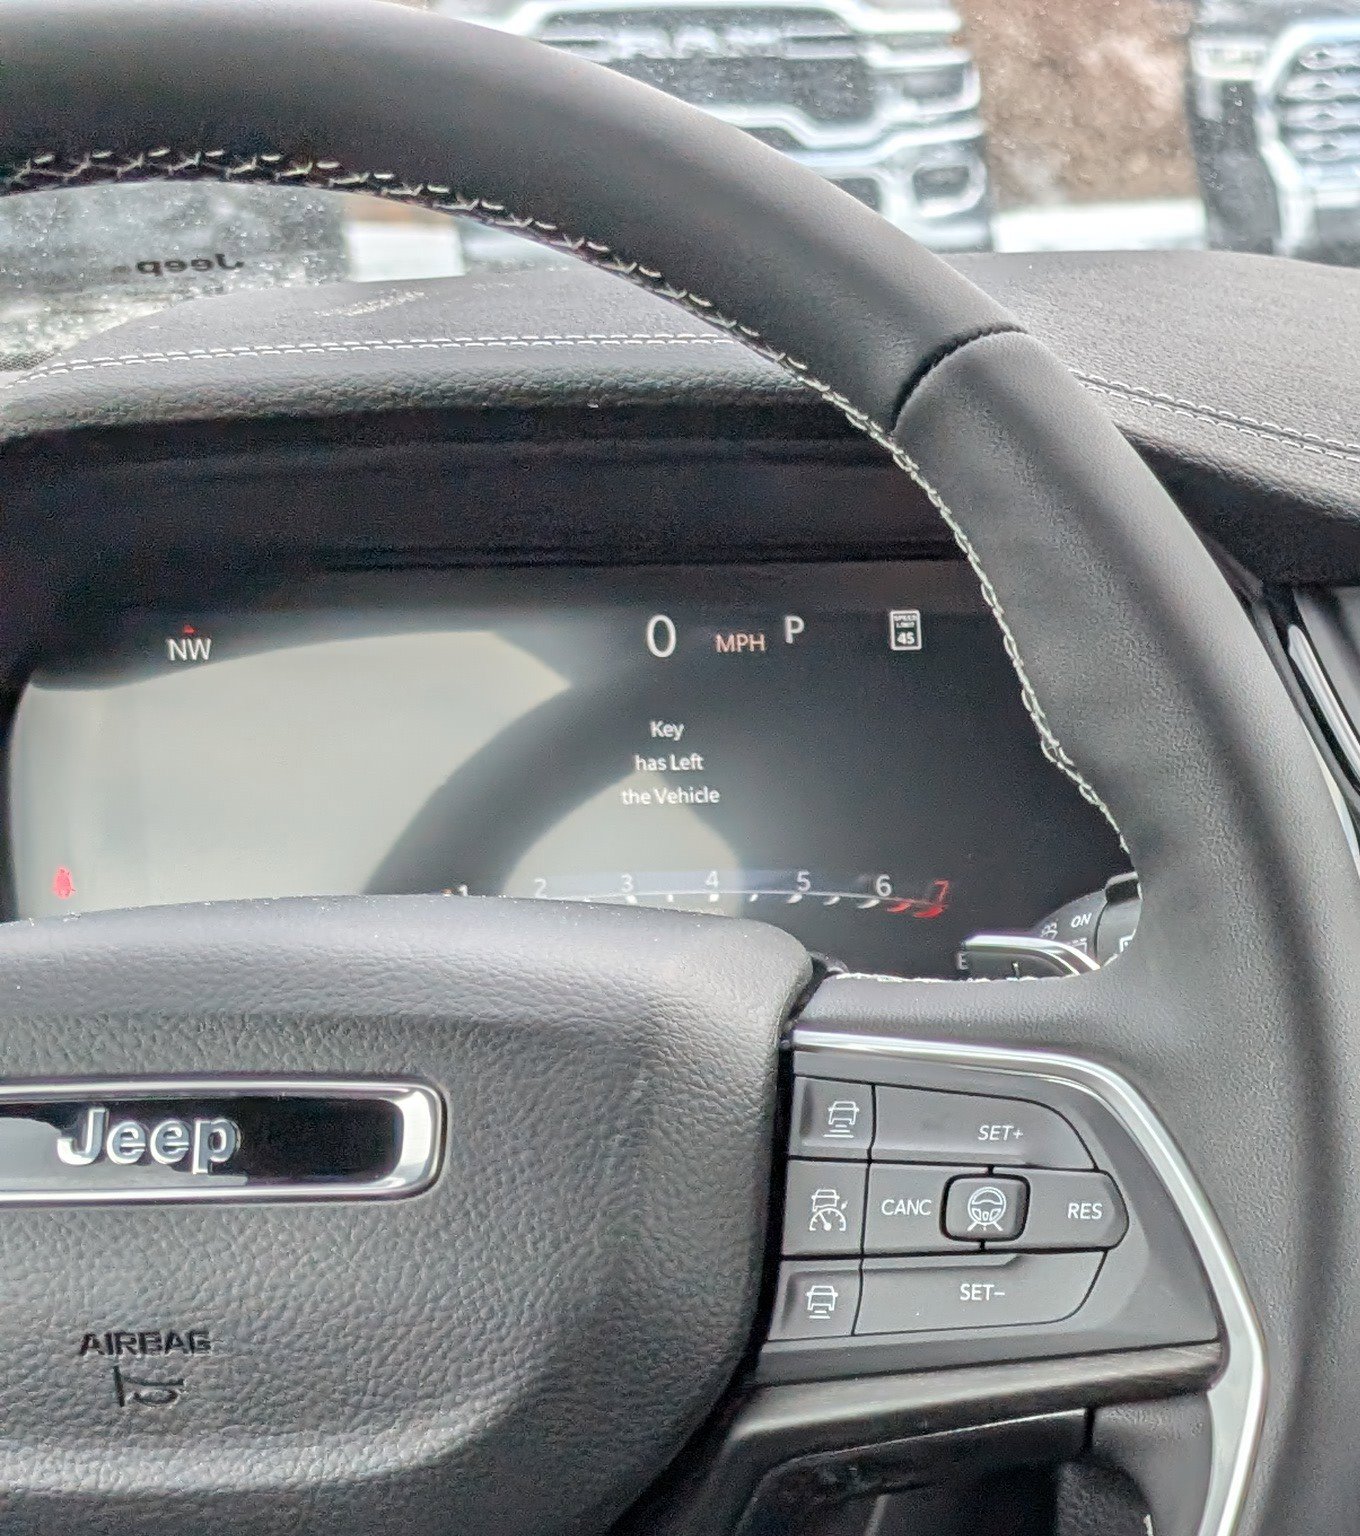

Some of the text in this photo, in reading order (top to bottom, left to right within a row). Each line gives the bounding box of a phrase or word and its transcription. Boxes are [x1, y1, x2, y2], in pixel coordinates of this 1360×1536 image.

[647, 614, 677, 658] 0
[784, 615, 805, 644] P
[897, 631, 915, 645] 45
[166, 637, 213, 661] NW
[715, 633, 766, 653] MPH
[650, 719, 685, 742] Key
[634, 752, 704, 771] has Left
[622, 786, 720, 805] the Vehicle
[534, 878, 548, 899] 2
[620, 873, 634, 894] 3
[704, 869, 720, 890] 4
[796, 871, 811, 892] 5
[876, 874, 891, 898] 6
[933, 879, 950, 903] 7
[1071, 912, 1093, 928] ON
[56, 1107, 242, 1175] Jeep
[977, 1125, 1024, 1142] SET+
[881, 1199, 932, 1216] CANC
[1068, 1203, 1103, 1220] RES
[79, 1329, 215, 1357] AIRBAG
